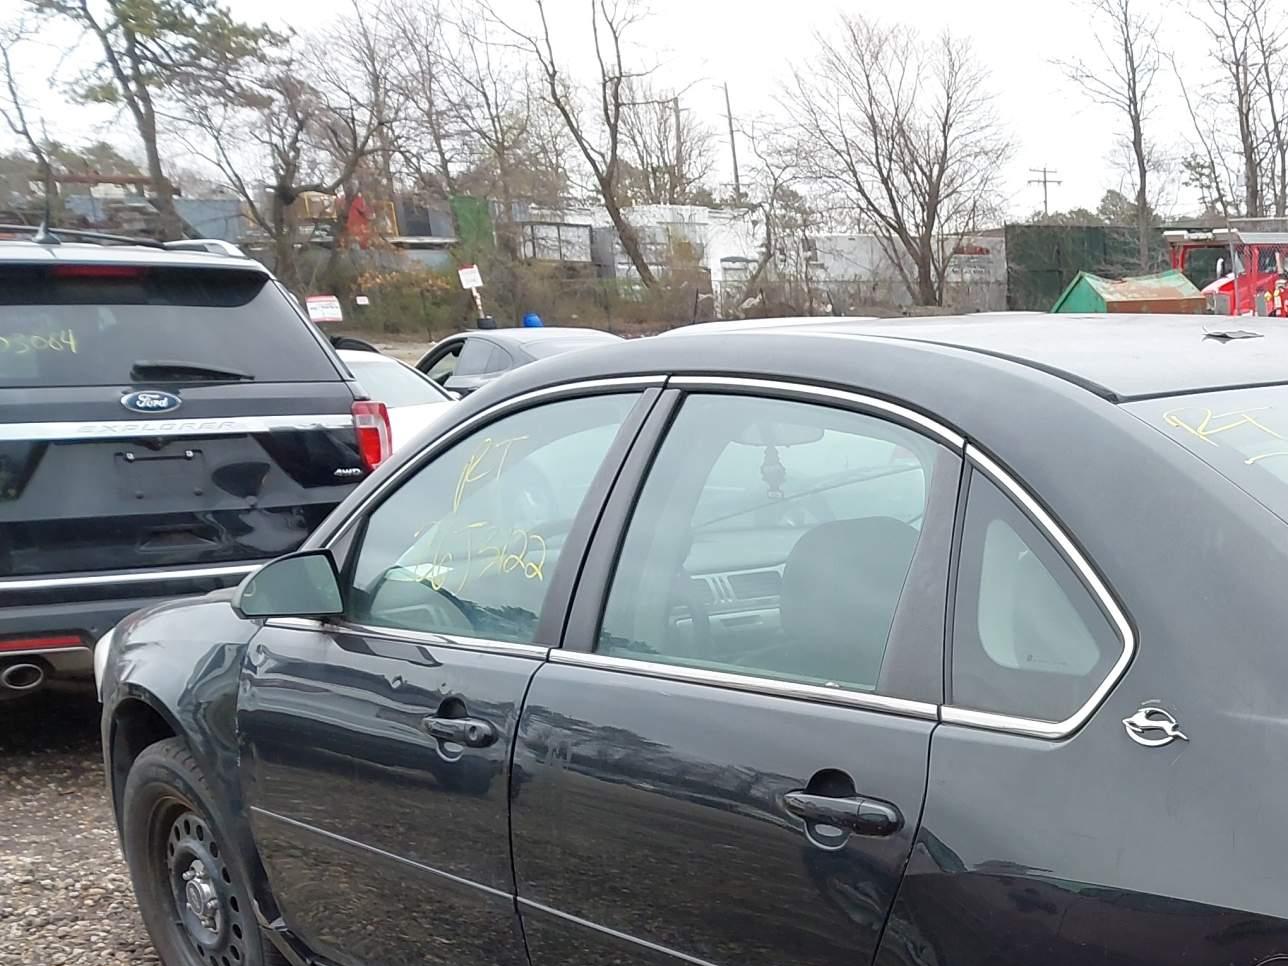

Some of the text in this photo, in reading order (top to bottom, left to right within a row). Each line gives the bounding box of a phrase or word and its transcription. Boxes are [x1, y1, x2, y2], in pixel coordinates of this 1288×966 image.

[136, 393, 168, 408] Ford
[78, 420, 236, 434] EXPLORER
[333, 467, 362, 477] AWD
